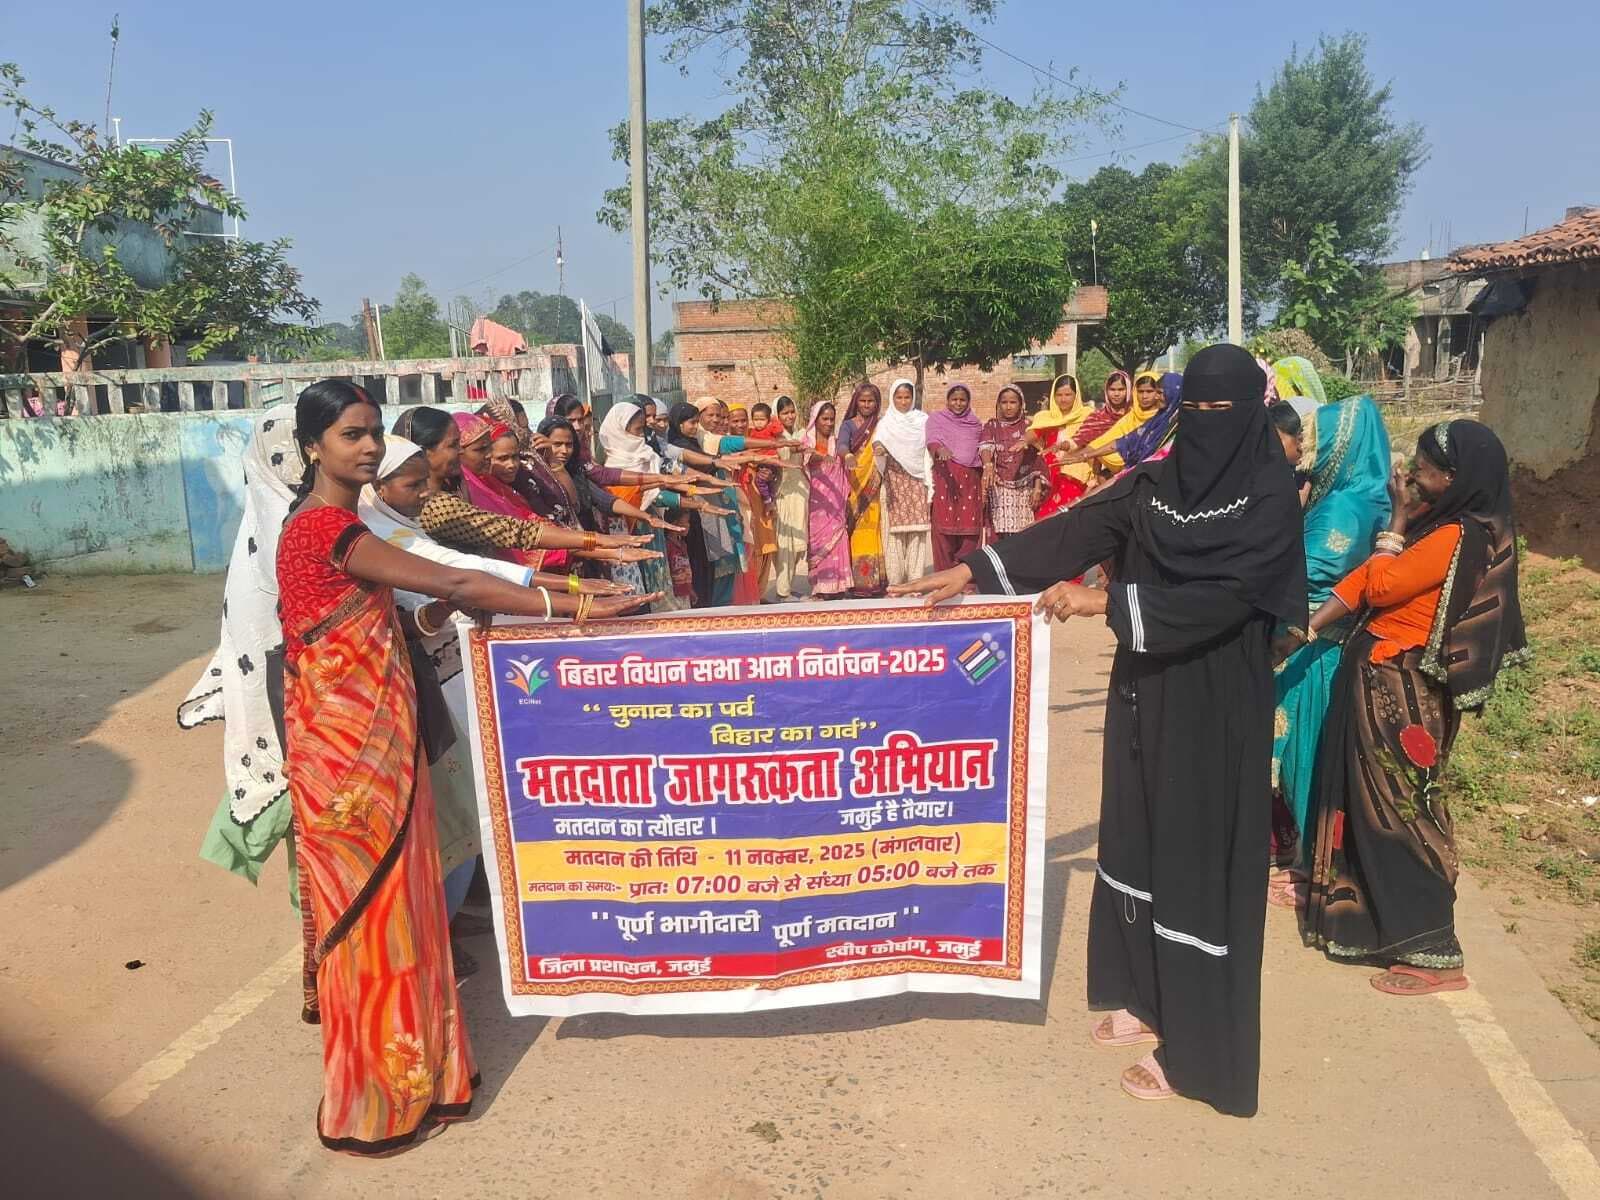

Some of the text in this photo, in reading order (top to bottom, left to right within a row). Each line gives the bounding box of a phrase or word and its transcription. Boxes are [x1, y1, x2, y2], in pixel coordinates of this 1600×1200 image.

[557, 657, 618, 687] बिहार
[622, 655, 689, 685] विधान
[691, 656, 742, 683] सभा
[747, 654, 794, 680] आम
[796, 646, 945, 678] निर्वाचन-2025
[608, 702, 674, 729] चुनाव
[679, 702, 714, 720] का
[718, 694, 756, 718] पर्व
[710, 723, 774, 746] बिहार
[779, 725, 812, 742] का
[518, 755, 655, 806] मतदाता
[851, 732, 997, 796] अभियान
[553, 817, 617, 837] मतदान
[618, 818, 644, 837] का
[645, 813, 705, 837] त्यौहार
[838, 801, 883, 831] जमुई
[884, 798, 900, 822] है
[564, 849, 626, 868] मतदान
[628, 847, 652, 869] की
[656, 846, 698, 868] तिथि
[725, 849, 741, 866] 11
[745, 847, 814, 866] नवम्बर,
[819, 842, 866, 862] 2025
[872, 832, 961, 860] (मंगलवार)
[528, 881, 567, 893] मतदान
[568, 881, 583, 893] का
[675, 875, 741, 895] 07:00
[746, 874, 779, 895] बजे
[783, 873, 802, 893] से
[806, 870, 853, 890] संध्या
[857, 860, 920, 884] 05:00
[925, 861, 959, 879] बजे
[962, 862, 998, 878] तक
[615, 910, 655, 943] पूर्ण
[659, 909, 762, 935] भागीदारी
[772, 915, 813, 948] पूर्ण
[815, 911, 897, 934] मतदान
[538, 956, 713, 976] जिला प्रशासन, जमुई
[825, 937, 982, 960] स्वीप कोषांग, जमुई
